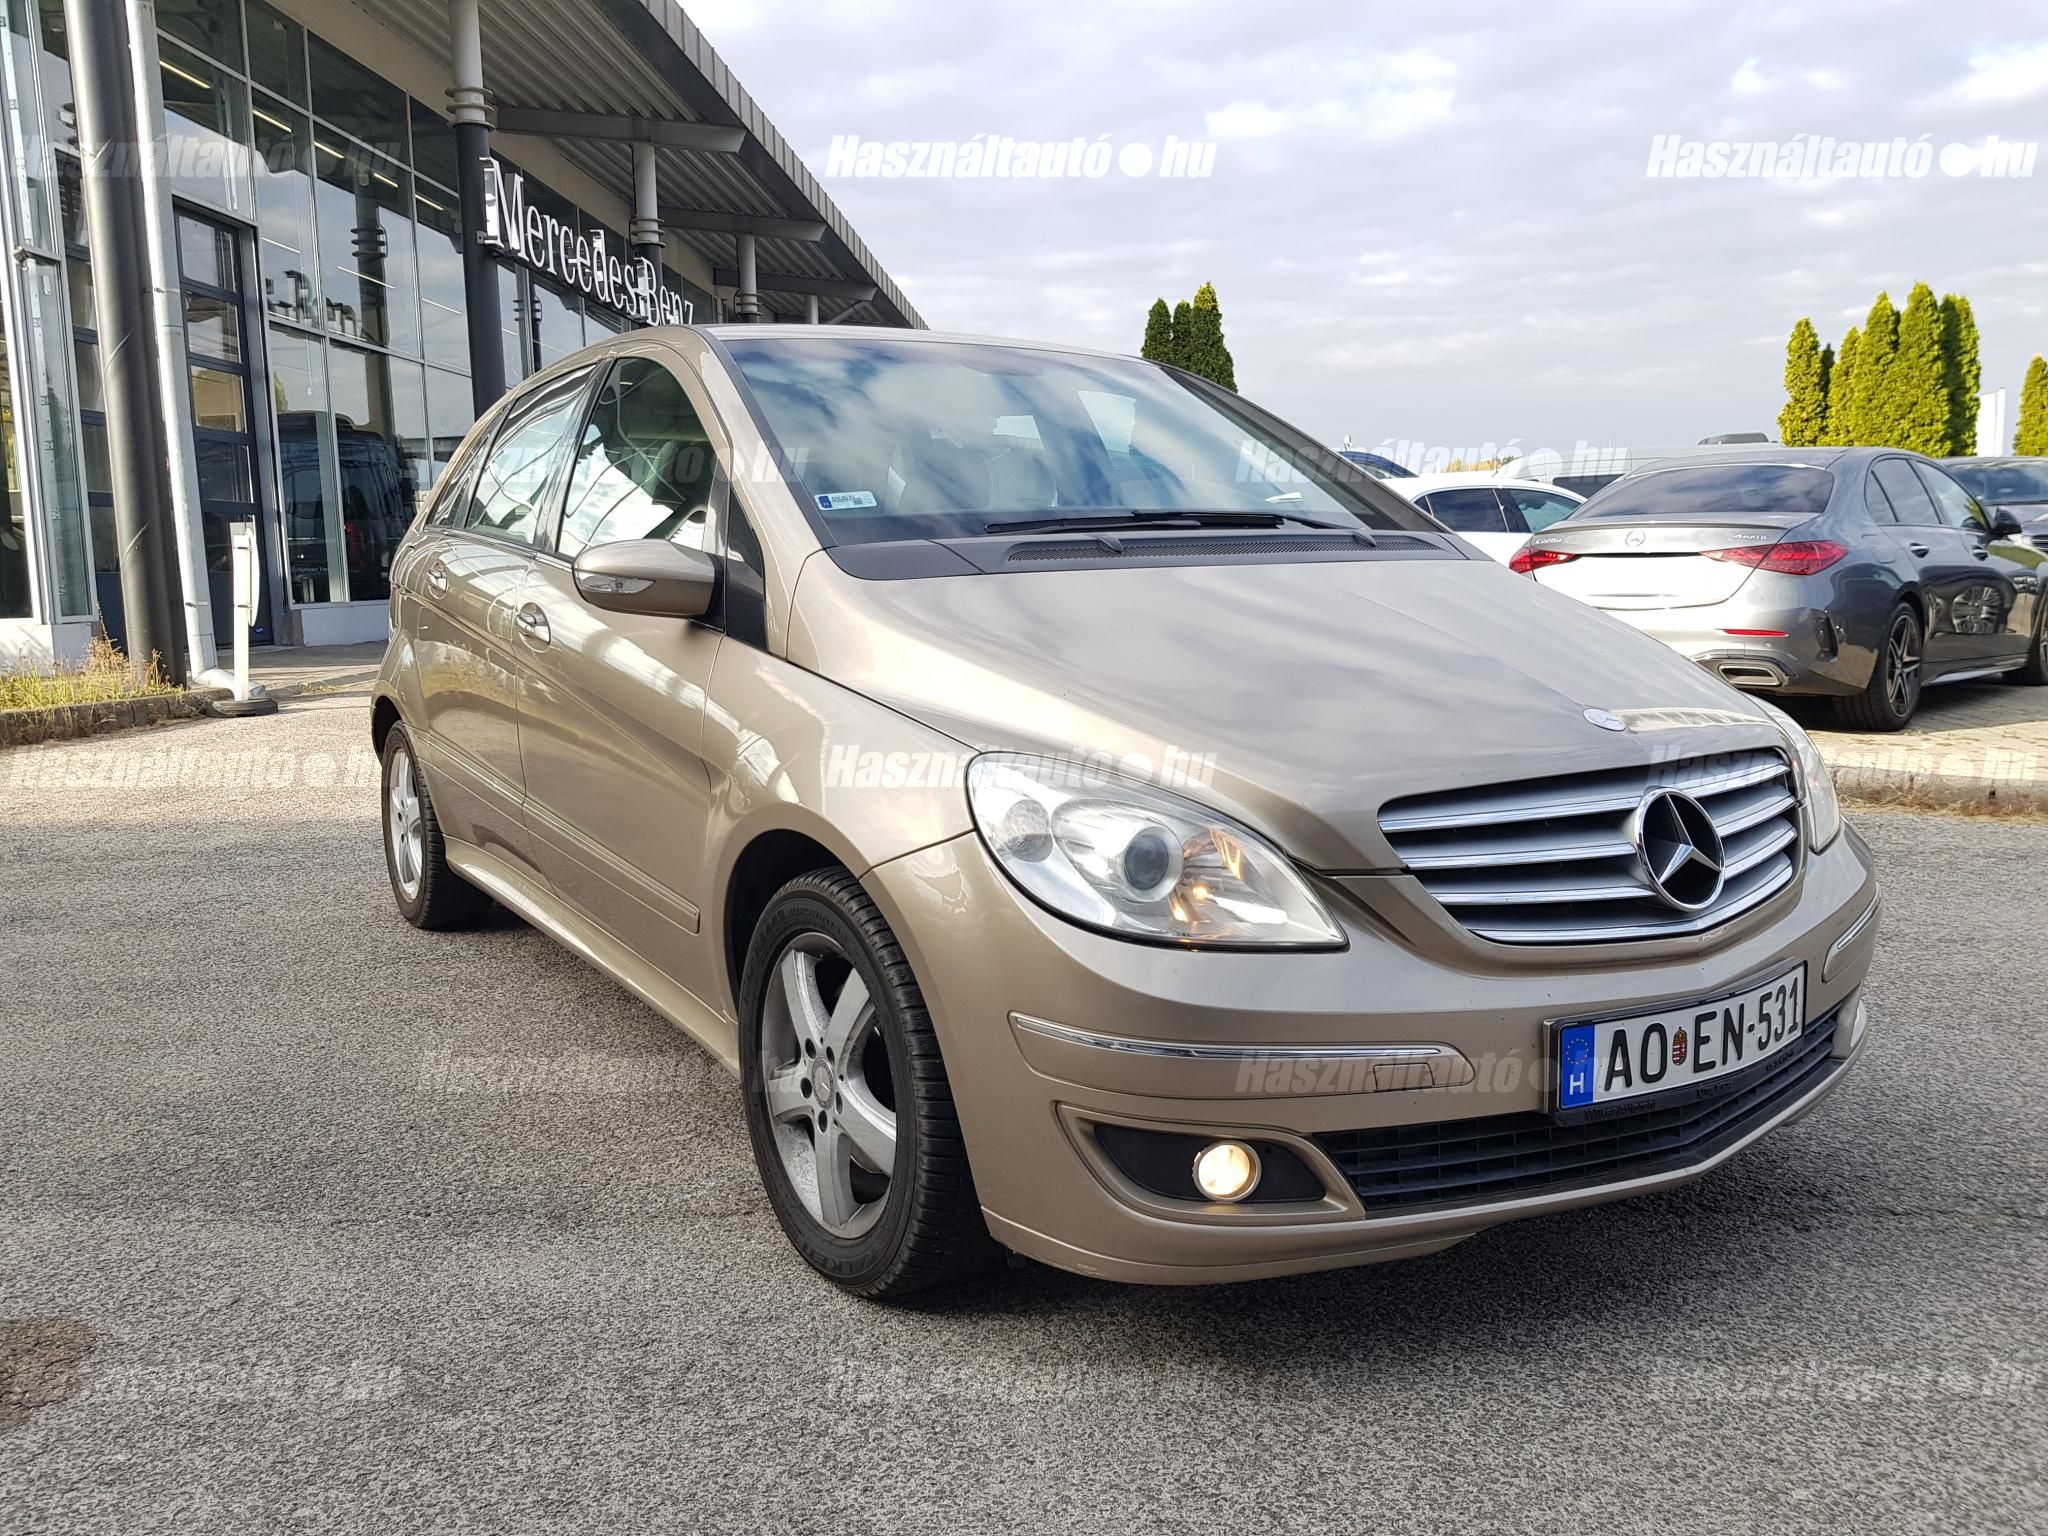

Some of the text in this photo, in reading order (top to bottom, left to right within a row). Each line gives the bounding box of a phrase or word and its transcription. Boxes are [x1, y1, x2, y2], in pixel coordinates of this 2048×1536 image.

[1604, 976, 1799, 1092] AO EN-531
[1569, 1072, 1585, 1096] H
